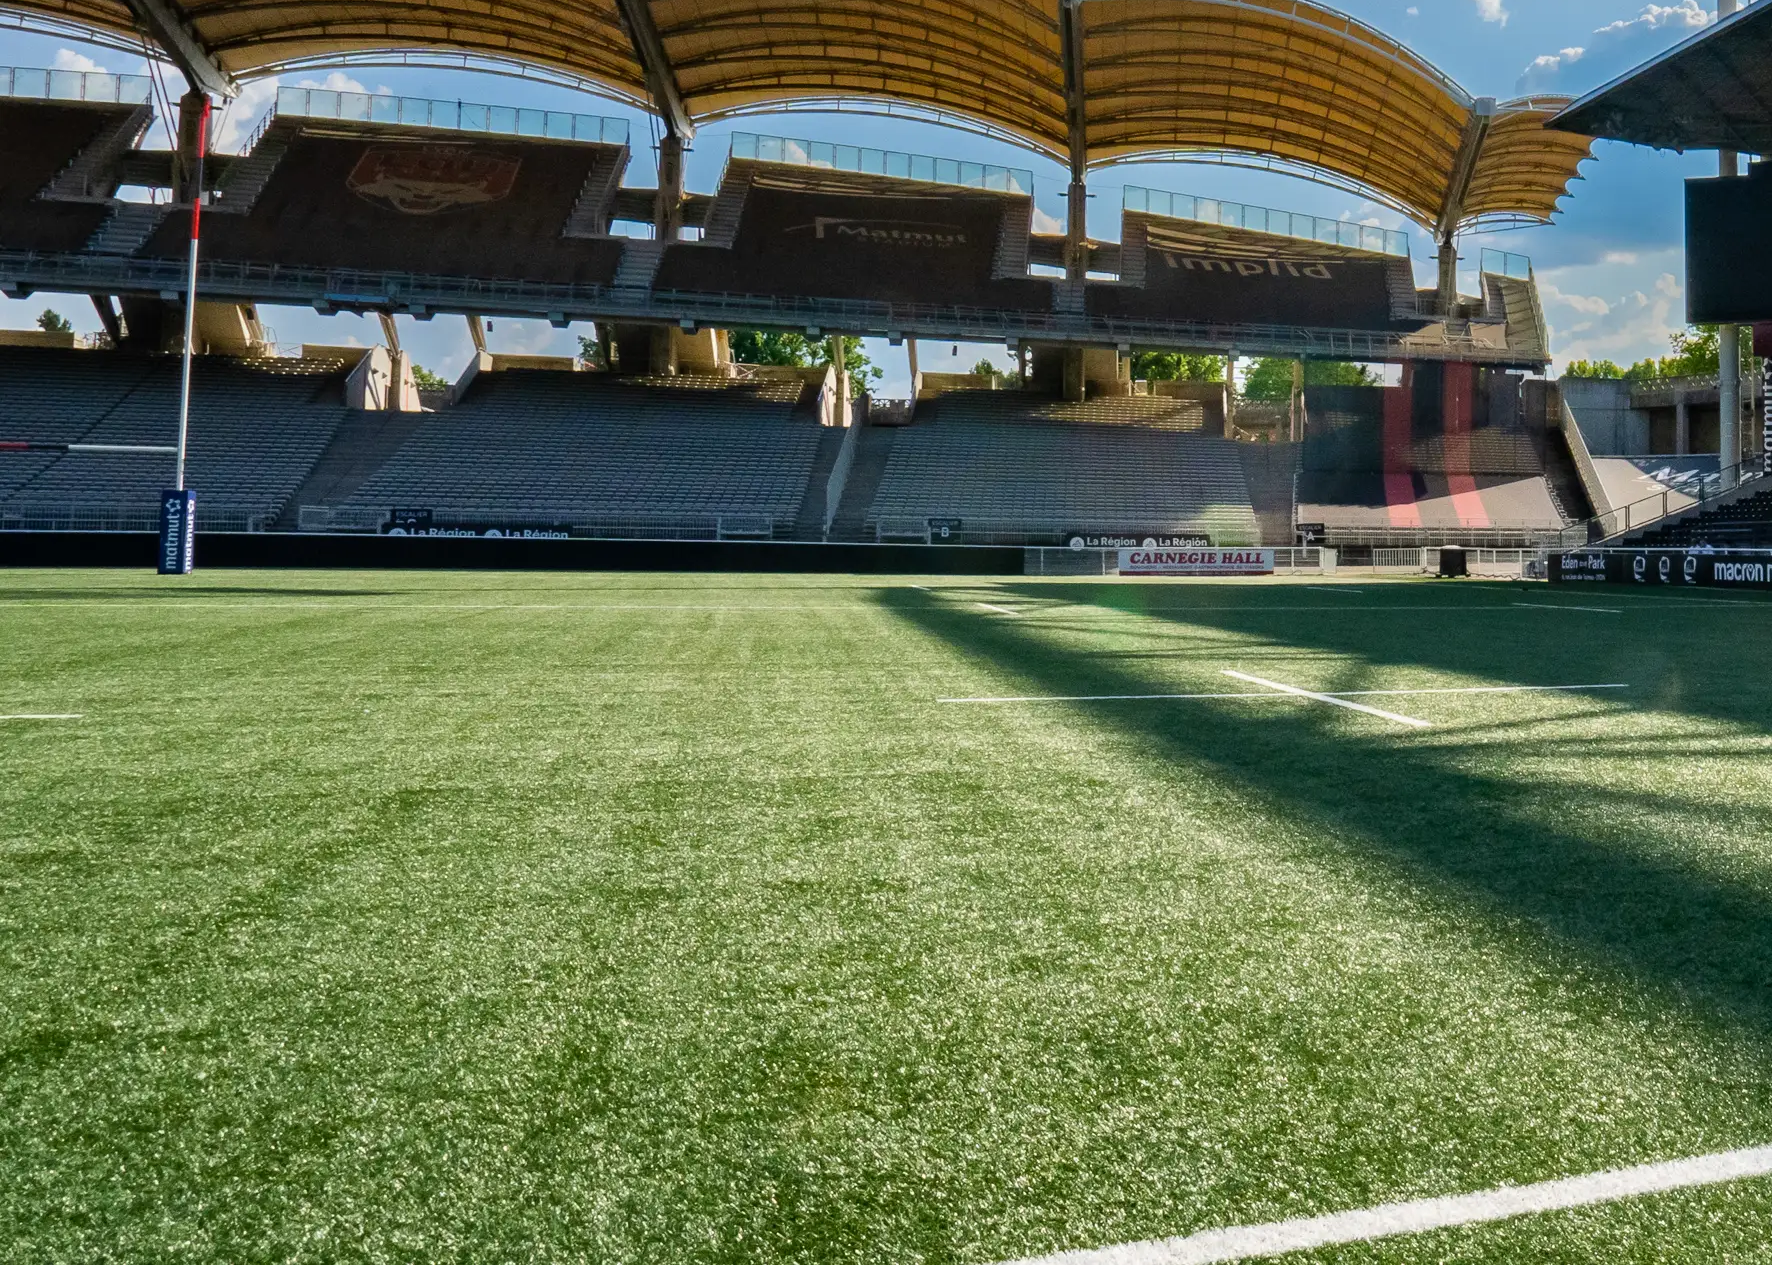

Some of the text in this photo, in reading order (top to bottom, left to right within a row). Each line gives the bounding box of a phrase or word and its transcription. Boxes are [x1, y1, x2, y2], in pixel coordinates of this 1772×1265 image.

[429, 528, 476, 537] Région
[164, 513, 180, 569] matmut
[185, 513, 195, 570] matmut
[1086, 537, 1137, 547] La Région
[1159, 537, 1208, 547] La Région
[1129, 552, 1265, 564] CARNEGIE HALL
[1561, 554, 1606, 569] Eden Park
[1714, 562, 1764, 581] macron
